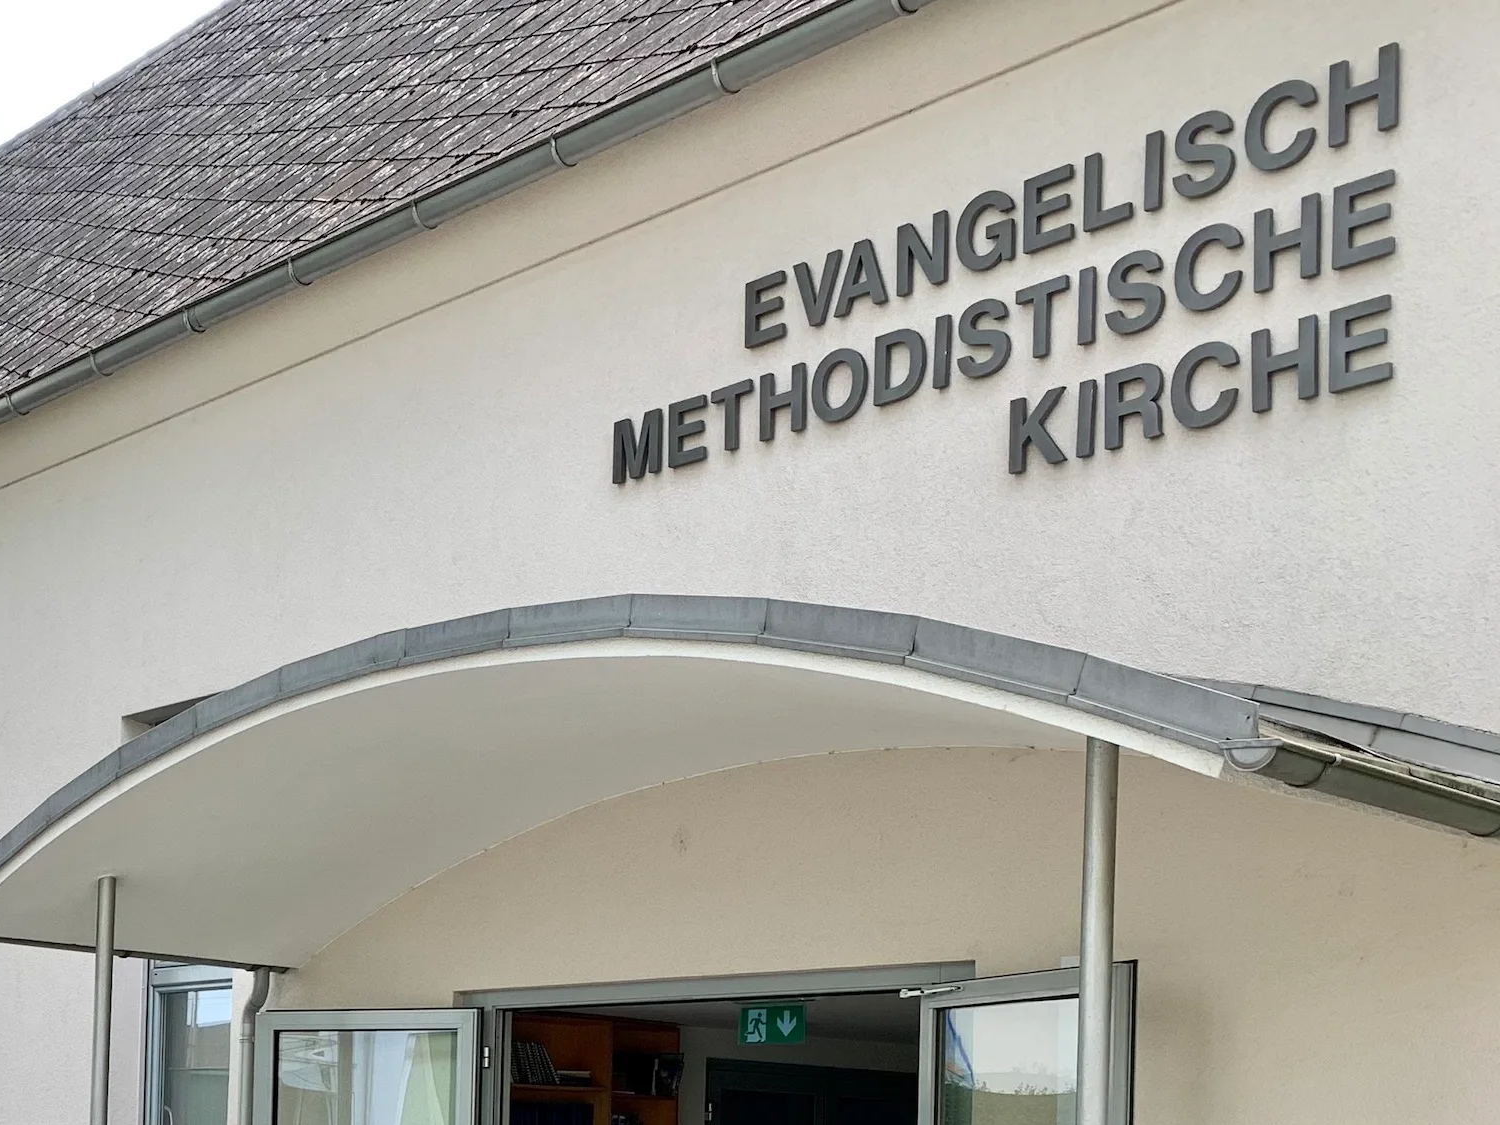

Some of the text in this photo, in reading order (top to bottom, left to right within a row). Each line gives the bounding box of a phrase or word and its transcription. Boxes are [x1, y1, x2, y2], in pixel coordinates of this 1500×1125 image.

[612, 169, 1396, 485] METHODISTISCHE
[744, 42, 1400, 349] EVANGELISCH
[1008, 294, 1394, 475] KIRCHE
